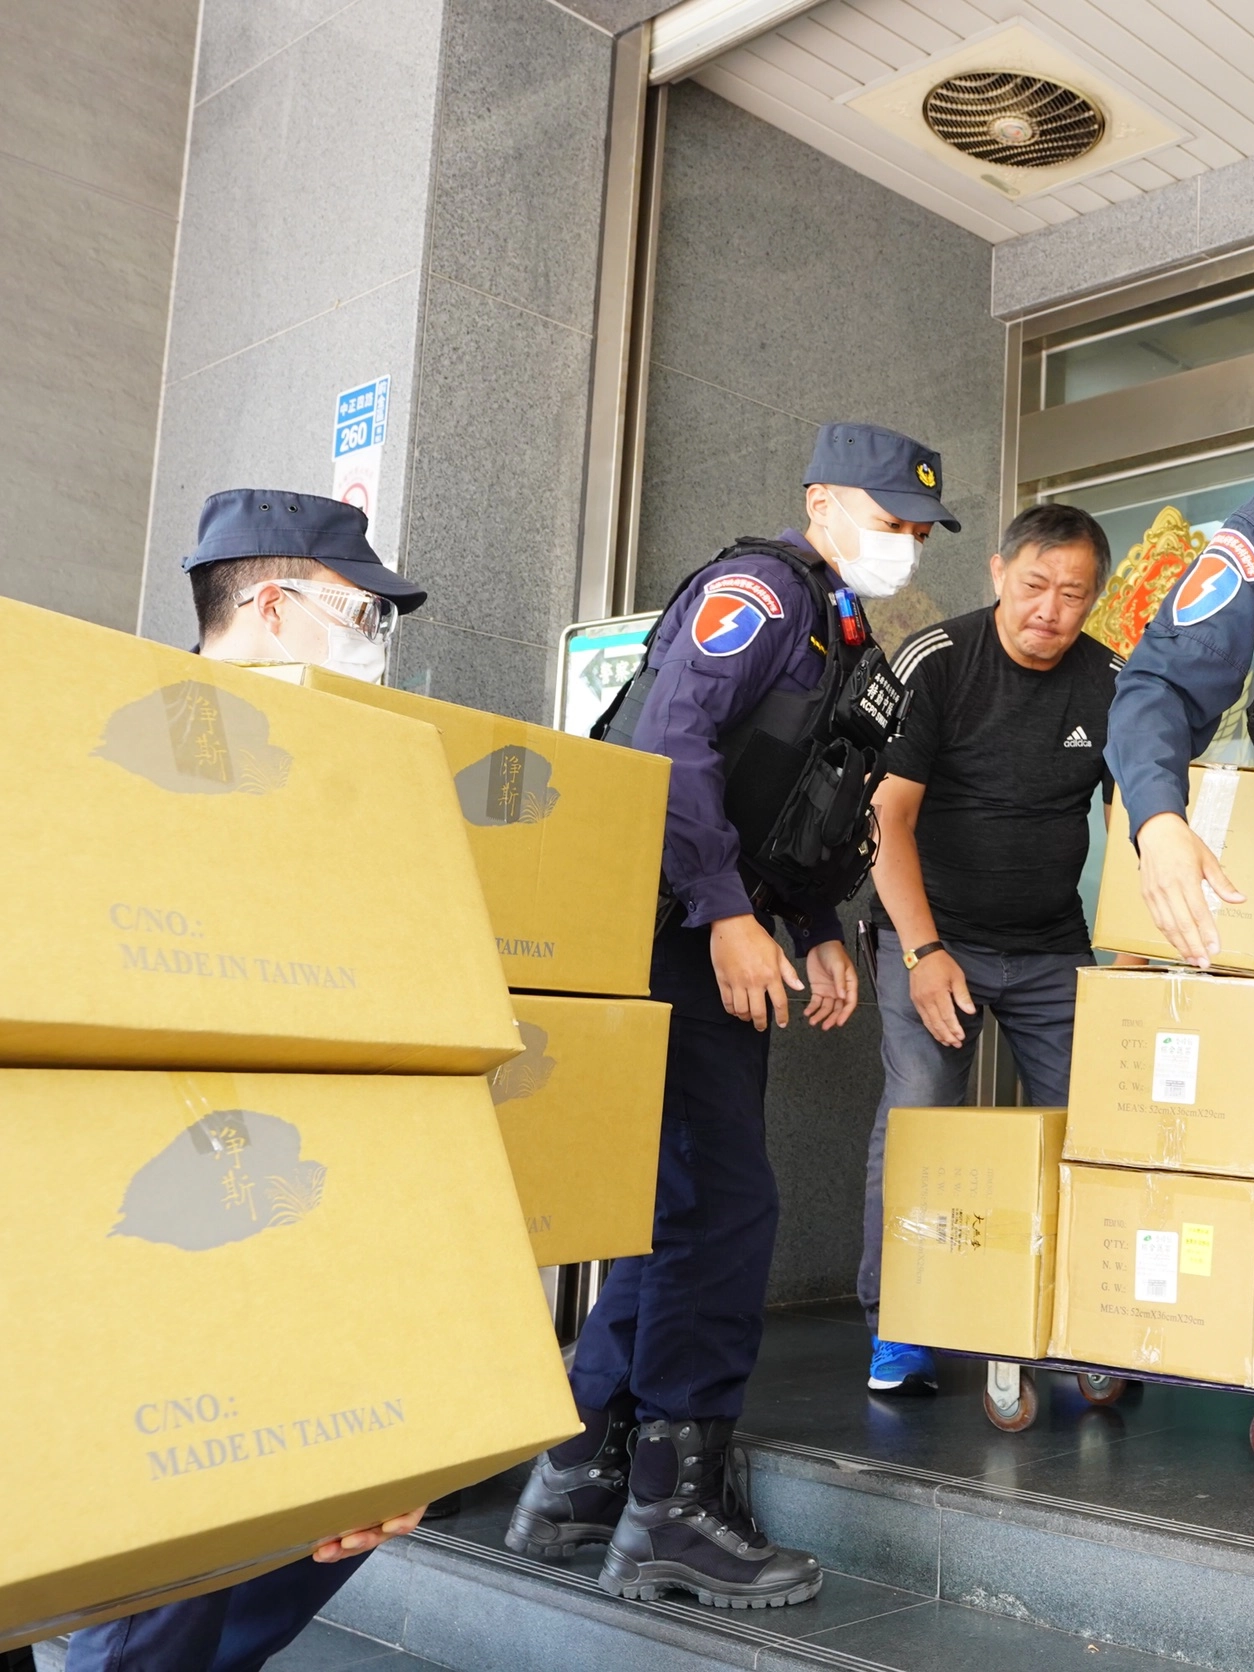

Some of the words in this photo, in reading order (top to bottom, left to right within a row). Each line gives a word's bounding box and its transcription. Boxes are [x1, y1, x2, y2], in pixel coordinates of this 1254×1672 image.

[340, 392, 373, 416] 中正四路
[340, 422, 367, 452] 260
[1063, 738, 1092, 748] adidas
[109, 902, 204, 940] C/NO.:
[119, 943, 212, 981] MADE
[220, 954, 248, 981] IN
[255, 958, 357, 990] TAIWAN
[134, 1392, 240, 1435] C/NO.:
[146, 1425, 250, 1482] MADE
[256, 1420, 287, 1457] IN
[293, 1398, 406, 1449] TAIWAN
